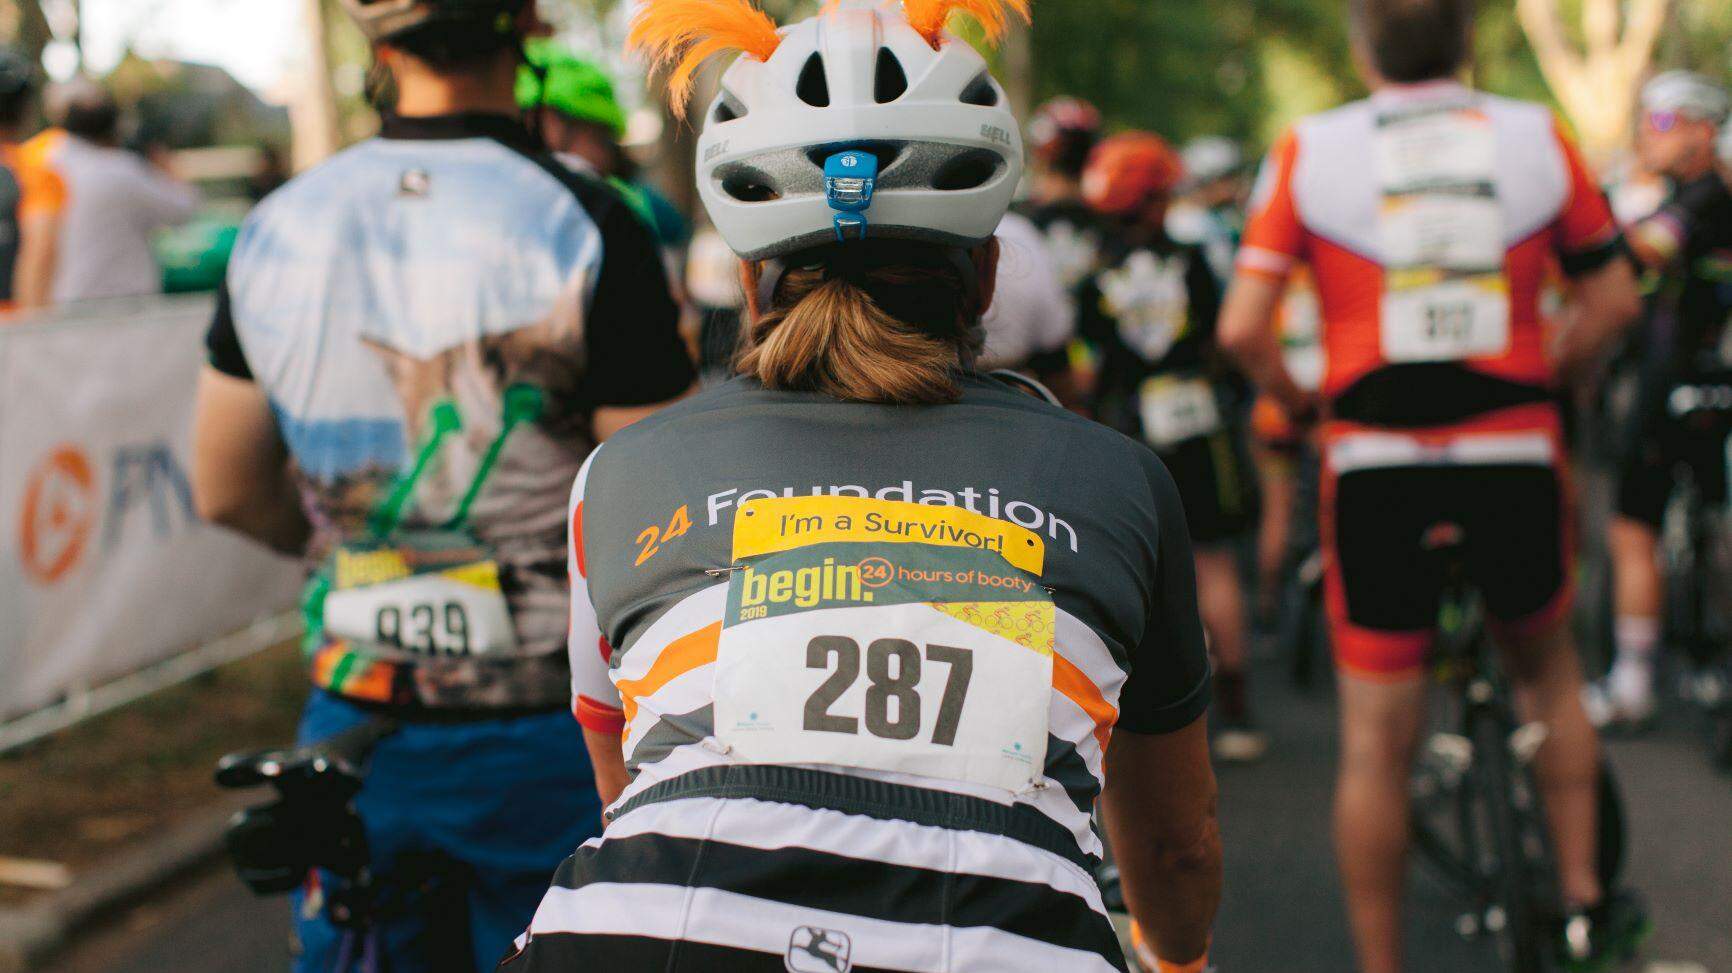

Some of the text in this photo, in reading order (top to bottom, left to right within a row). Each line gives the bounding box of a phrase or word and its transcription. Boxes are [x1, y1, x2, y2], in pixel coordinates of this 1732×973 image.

[633, 503, 693, 567] 24
[780, 512, 1004, 550] I'm a Survivor!
[898, 565, 951, 583] hours
[955, 568, 976, 584] of
[977, 571, 1034, 593] booty
[740, 605, 768, 621] 2019
[802, 634, 974, 747] 287
